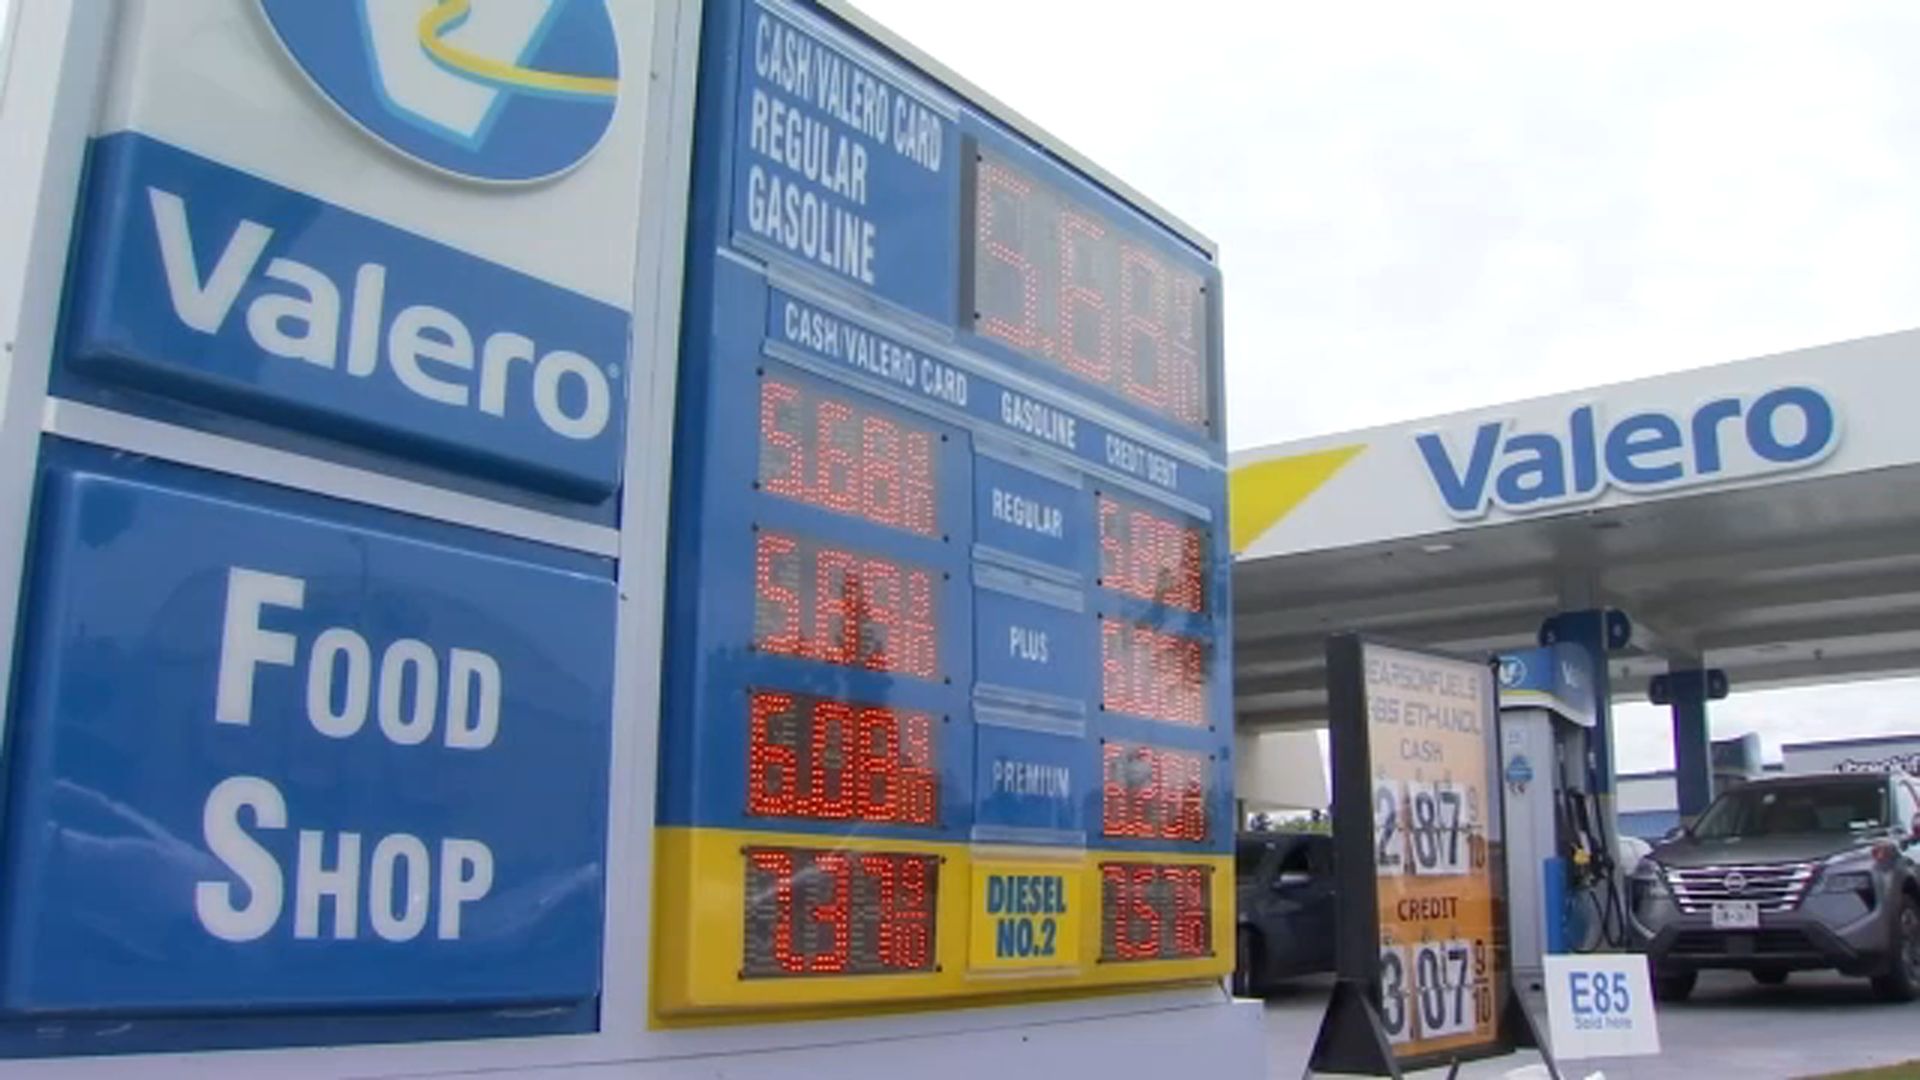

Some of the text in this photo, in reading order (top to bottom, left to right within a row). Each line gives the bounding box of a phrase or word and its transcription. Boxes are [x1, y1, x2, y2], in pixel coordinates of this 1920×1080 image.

[751, 88, 868, 206] REGULAR
[893, 94, 943, 173] CARD
[748, 164, 876, 286] GASOLINE
[147, 185, 611, 440] Valero
[920, 358, 968, 407] CARD
[1001, 390, 1077, 450] GASOLINE
[761, 381, 900, 526] 5.68
[1414, 384, 1835, 512] Valero
[992, 487, 1064, 540] REGULAR
[215, 566, 502, 751] FOOD
[1009, 625, 1049, 665] PLUS
[1370, 696, 1481, 736] 85 ETHANOL
[1400, 737, 1444, 763] CASH
[751, 694, 898, 821] 6.08
[992, 760, 1070, 799] PREMIUM
[195, 775, 495, 943] SHOP
[986, 874, 1067, 914] DIESEL
[996, 917, 1057, 959] NO.2
[1397, 896, 1459, 922] CREDIT
[1568, 971, 1631, 1014] E85
